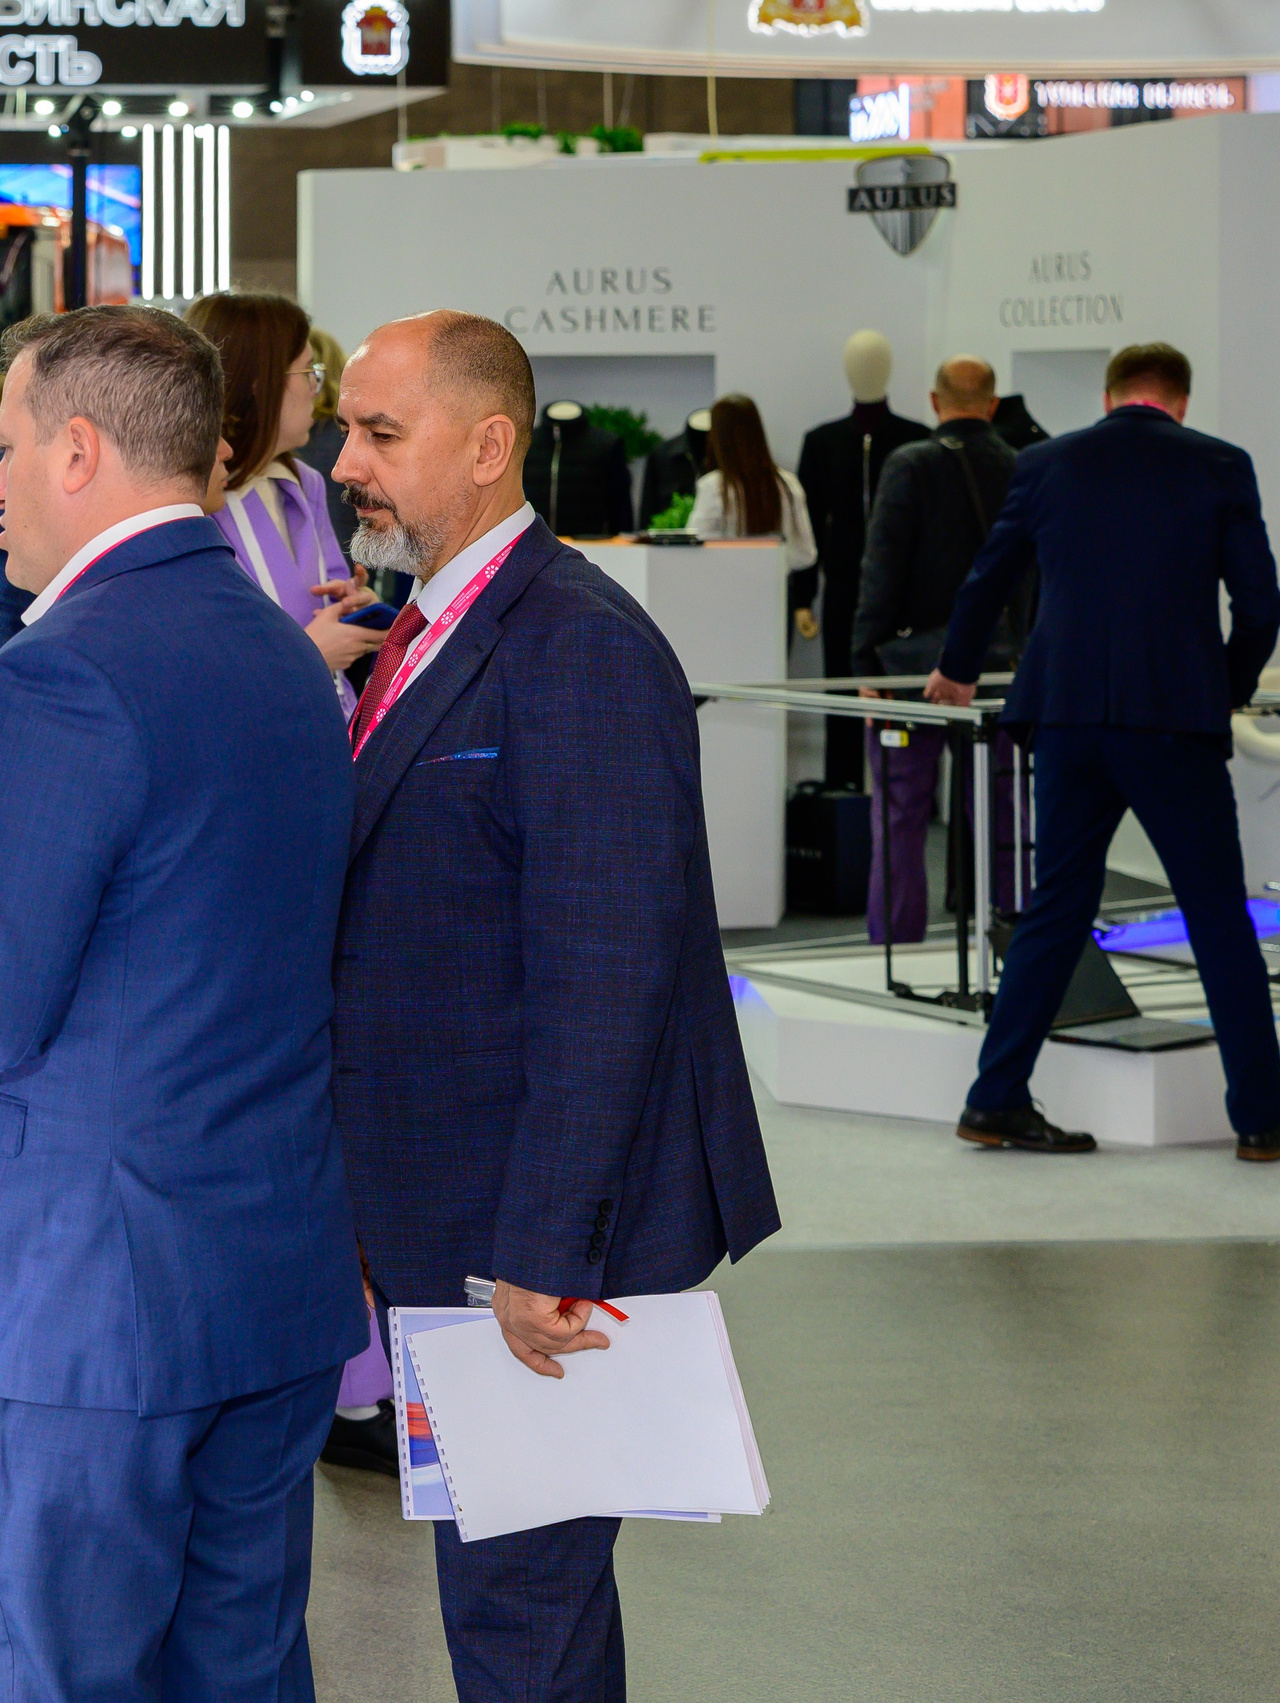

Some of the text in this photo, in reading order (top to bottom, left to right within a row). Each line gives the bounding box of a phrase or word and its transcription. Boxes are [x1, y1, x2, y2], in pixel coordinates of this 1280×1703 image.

[852, 185, 956, 212] AURUS
[545, 266, 673, 297] AURUS
[1030, 250, 1093, 285] AURUS
[503, 304, 718, 335] CASHMERE
[998, 293, 1125, 328] COLLECTION
